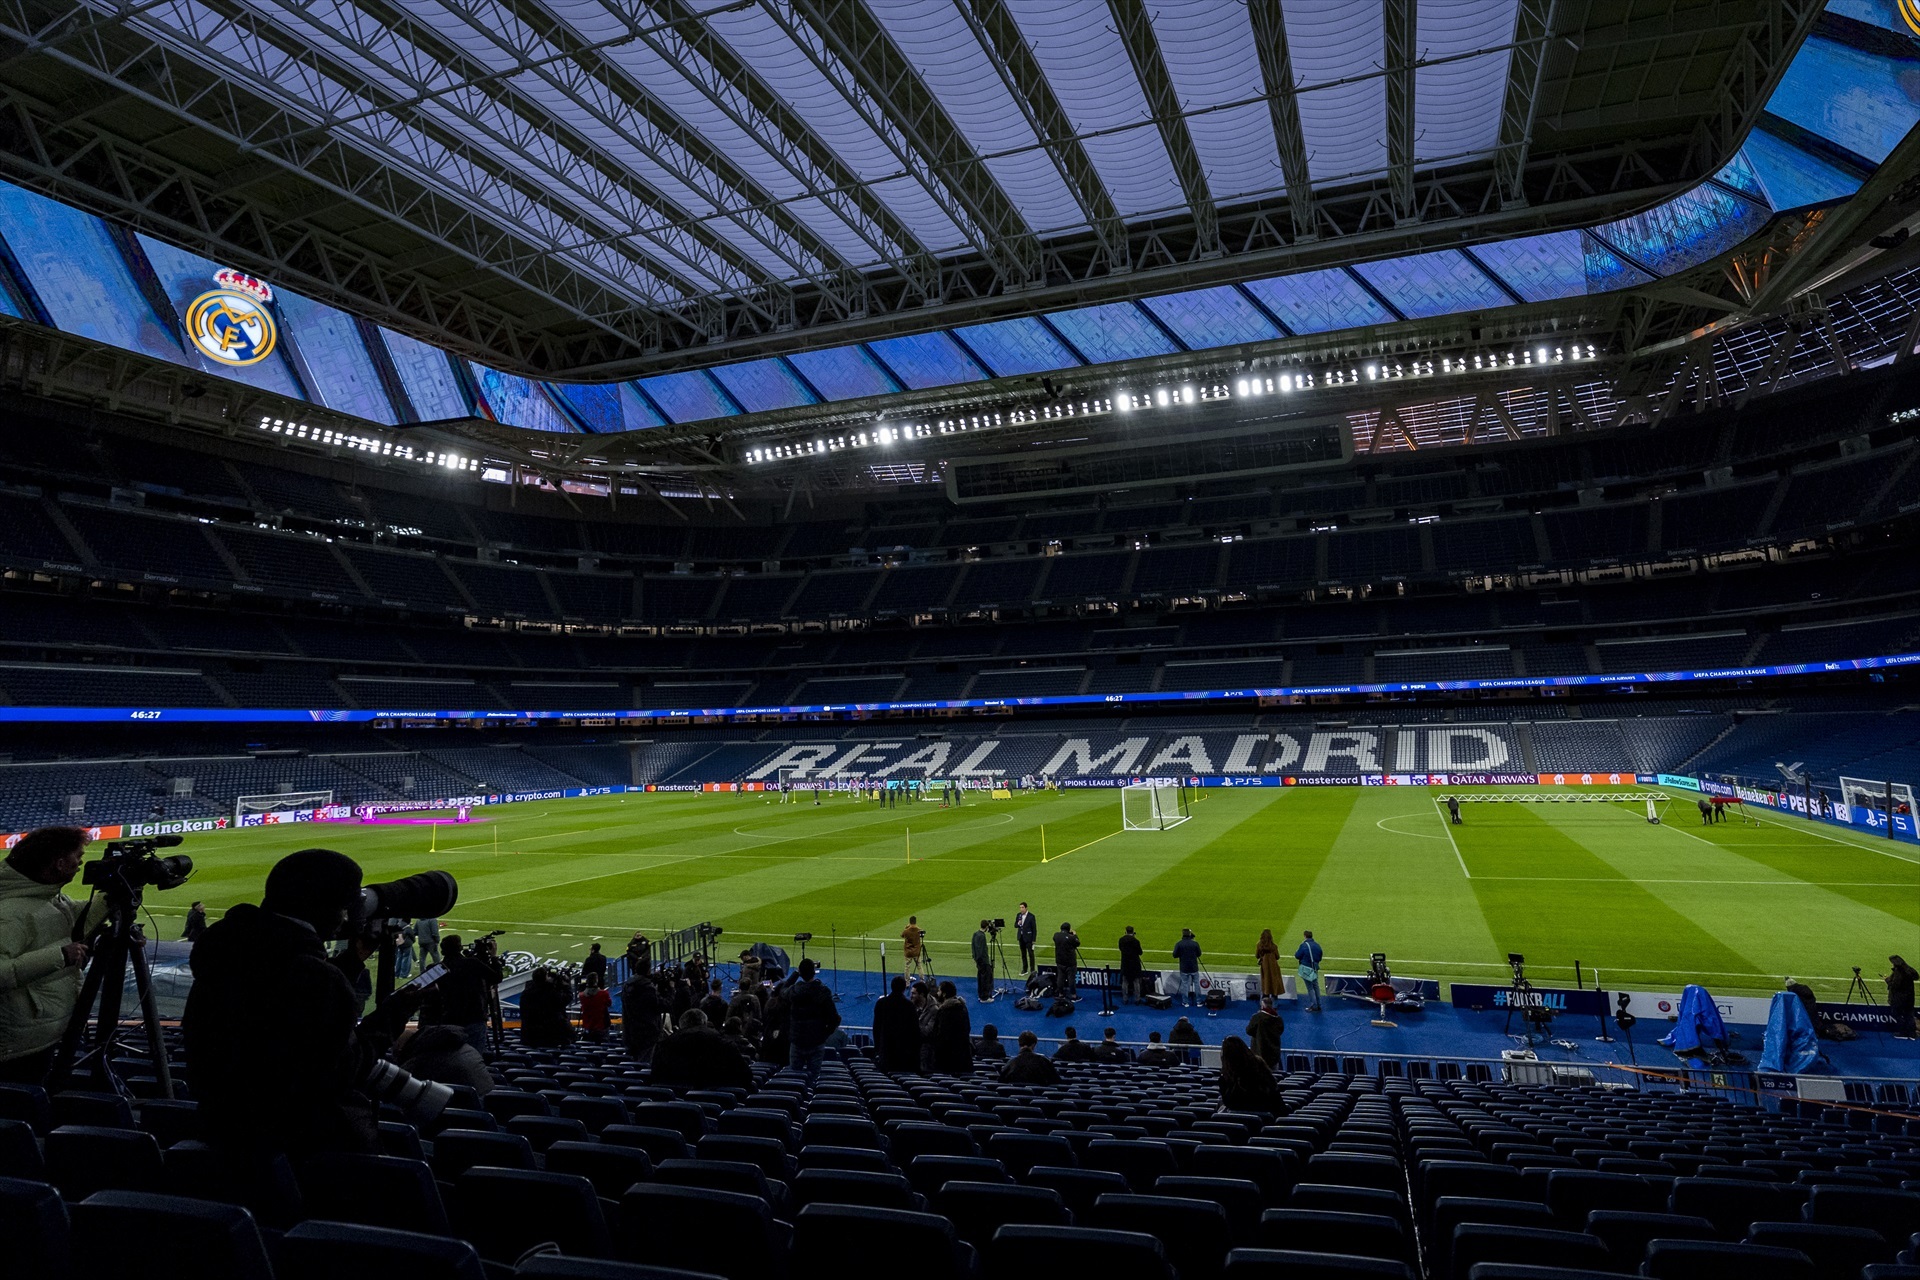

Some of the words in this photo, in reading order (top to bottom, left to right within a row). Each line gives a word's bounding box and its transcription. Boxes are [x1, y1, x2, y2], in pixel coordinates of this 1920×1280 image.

[130, 711, 161, 719] 46:27
[746, 740, 1006, 780] REAL
[1041, 729, 1509, 776] MADRID
[1089, 779, 1115, 787] LEAGUE
[1145, 777, 1180, 787] PEPS
[1235, 778, 1262, 786] PS5
[1298, 776, 1359, 785] mastercard
[1365, 776, 1398, 785] FedEx
[1410, 776, 1443, 785] FedEx
[1451, 775, 1486, 784] QATAR
[1490, 775, 1536, 784] AIRWAYS
[589, 787, 611, 795] PS5
[1705, 782, 1733, 796] crypto.com
[514, 791, 561, 802] crypto.com
[1735, 786, 1769, 805] Heineken
[242, 814, 280, 827] FedEx
[294, 809, 329, 822] FedEx
[1878, 813, 1907, 831] P5
[129, 819, 214, 837] Heineken
[1213, 979, 1259, 991] RESCT
[1833, 1011, 1898, 1025] CHAMPION
